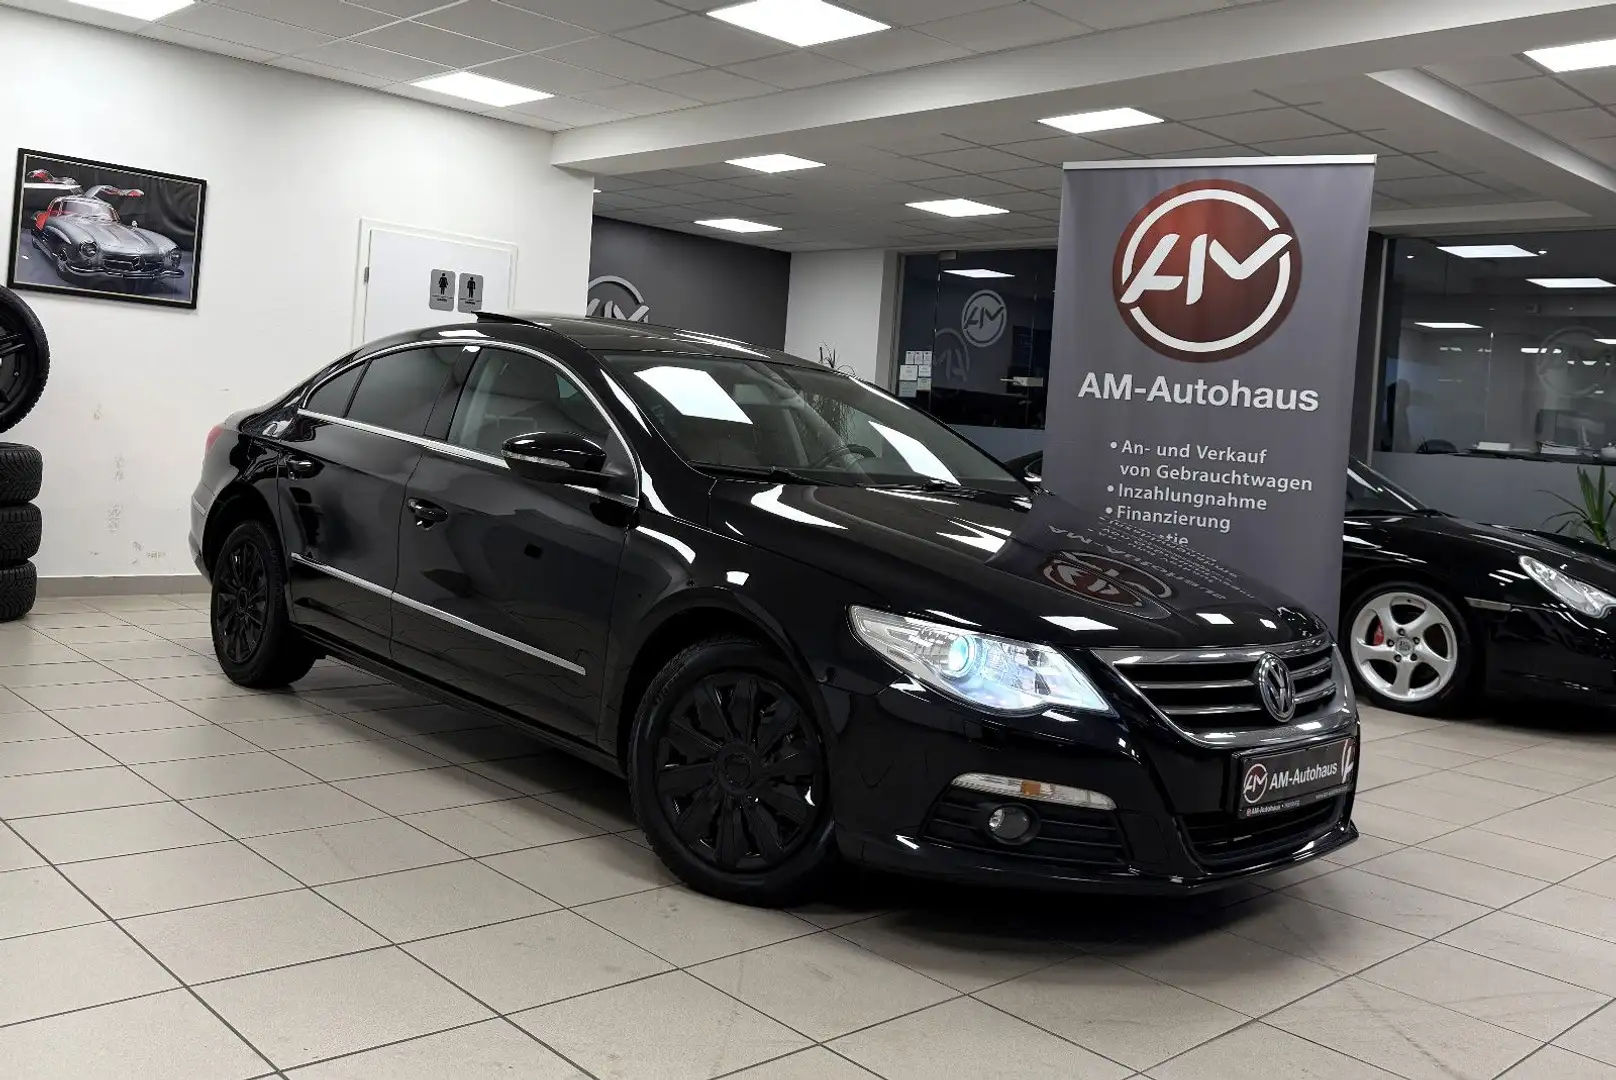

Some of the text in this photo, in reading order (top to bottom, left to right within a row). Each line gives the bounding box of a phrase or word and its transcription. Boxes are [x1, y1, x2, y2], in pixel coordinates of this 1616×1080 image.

[1078, 372, 1319, 411] AM-Autohaus
[1121, 440, 1267, 464] An- und Verkauf
[1120, 464, 1313, 492] von Gebrauchtwagen
[1118, 483, 1268, 511] Inzahlungnahme
[1117, 505, 1231, 533] Finanzierung
[1269, 762, 1338, 790] AM-Autohaus
